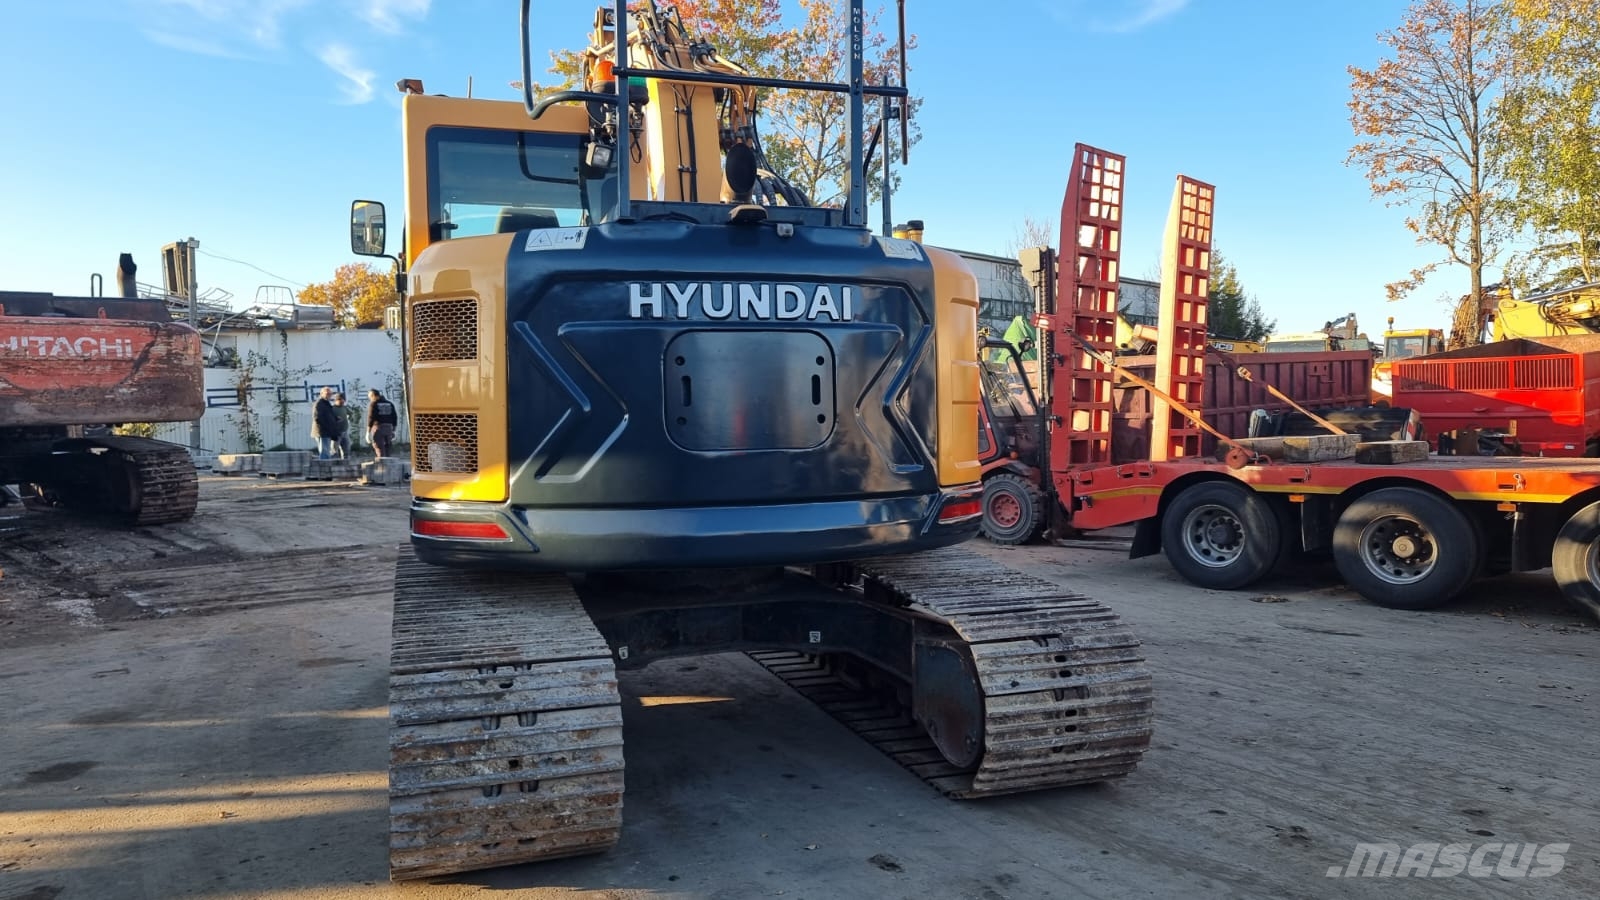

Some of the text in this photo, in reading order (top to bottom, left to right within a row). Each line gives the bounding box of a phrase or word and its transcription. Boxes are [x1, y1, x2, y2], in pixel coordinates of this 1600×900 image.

[853, 7, 861, 60] MOLSON
[630, 282, 852, 321] HYUNDAI
[0, 336, 133, 358] HITACHI
